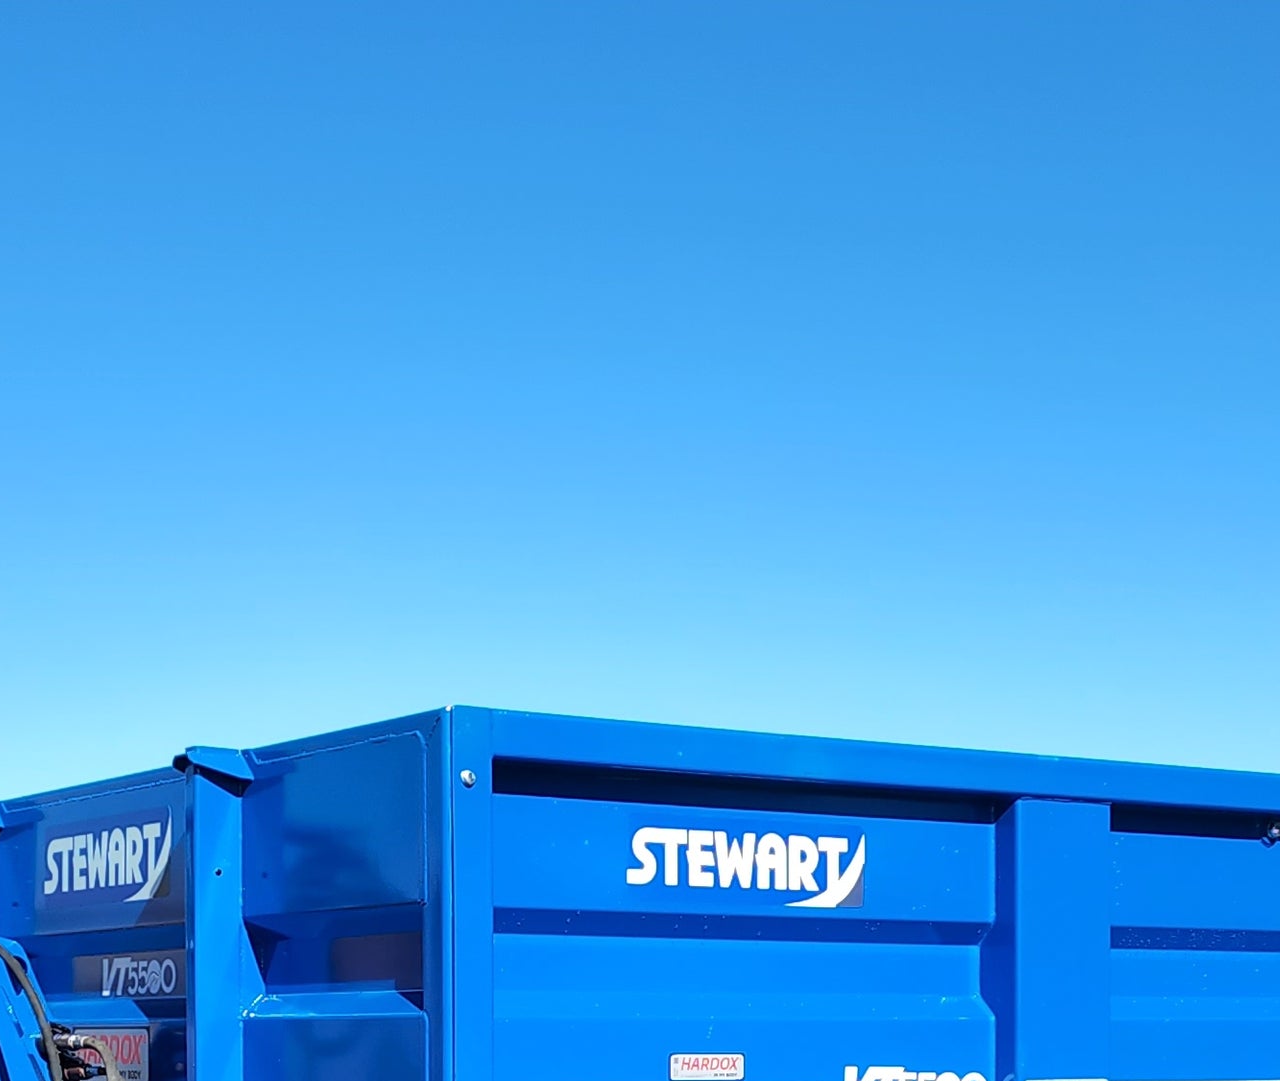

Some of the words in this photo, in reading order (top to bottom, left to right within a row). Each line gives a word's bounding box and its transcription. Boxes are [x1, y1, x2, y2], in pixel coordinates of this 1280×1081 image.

[44, 806, 172, 901] STEWART
[626, 827, 866, 908] STEWART
[102, 956, 177, 997] VT5500
[681, 1056, 739, 1071] HARDOX
